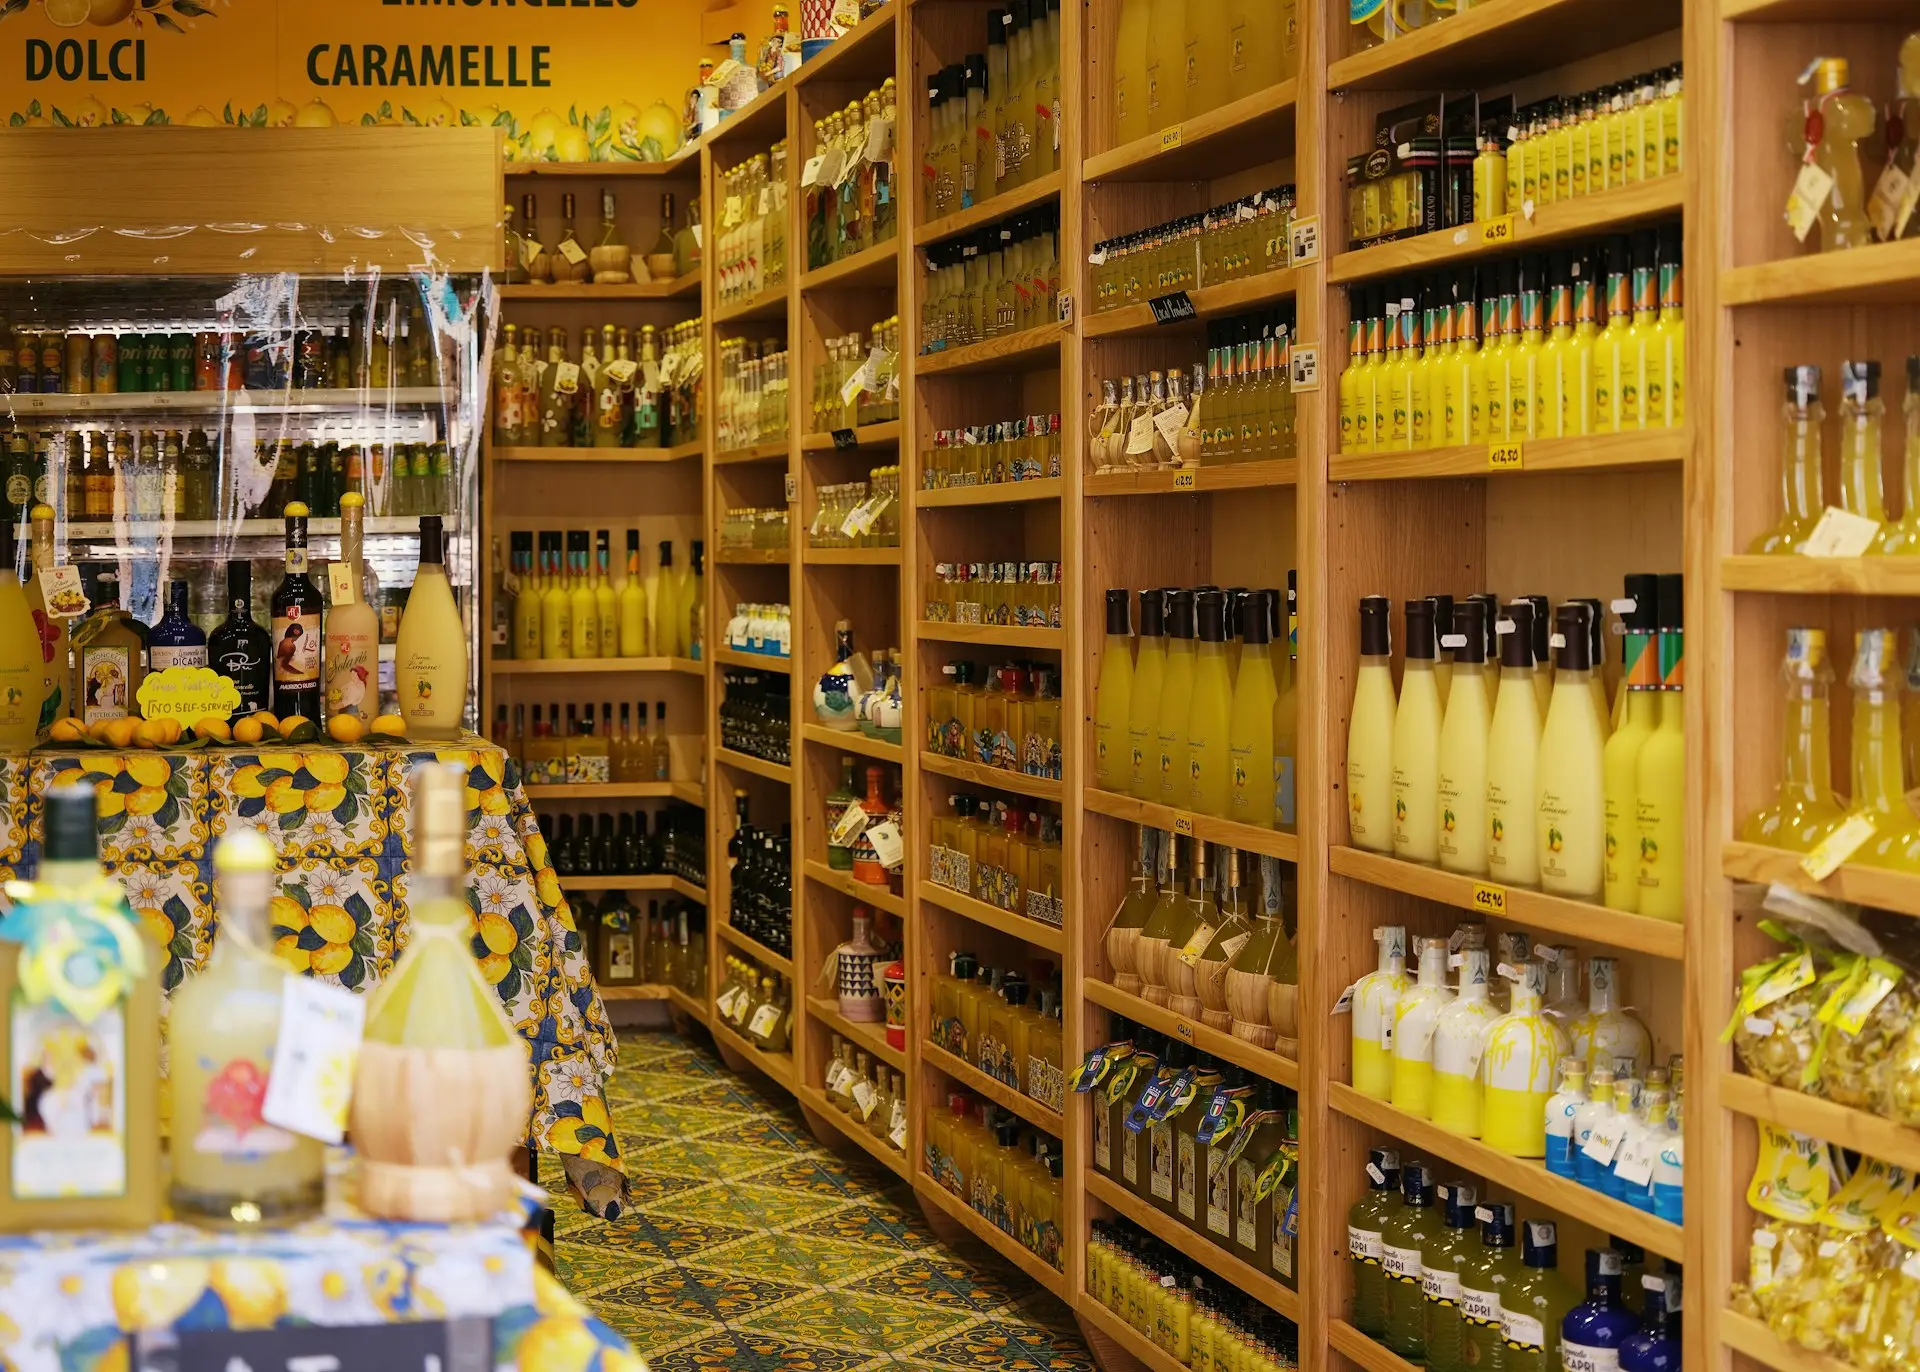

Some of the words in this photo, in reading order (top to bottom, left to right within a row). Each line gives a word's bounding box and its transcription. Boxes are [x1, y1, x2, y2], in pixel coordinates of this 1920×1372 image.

[25, 38, 147, 82] DOLCI
[306, 44, 551, 87] CARAMELLE
[1485, 223, 1508, 240] €6,50
[1152, 300, 1171, 321] Local
[1167, 298, 1194, 318] Products
[1492, 449, 1517, 464] €12,50
[1175, 475, 1193, 486] €12,50
[1476, 889, 1503, 908] €25,90
[1383, 1256, 1404, 1272] CAPRI
[1422, 1280, 1441, 1294] CAPRI
[1566, 1357, 1595, 1372] CAPRI
